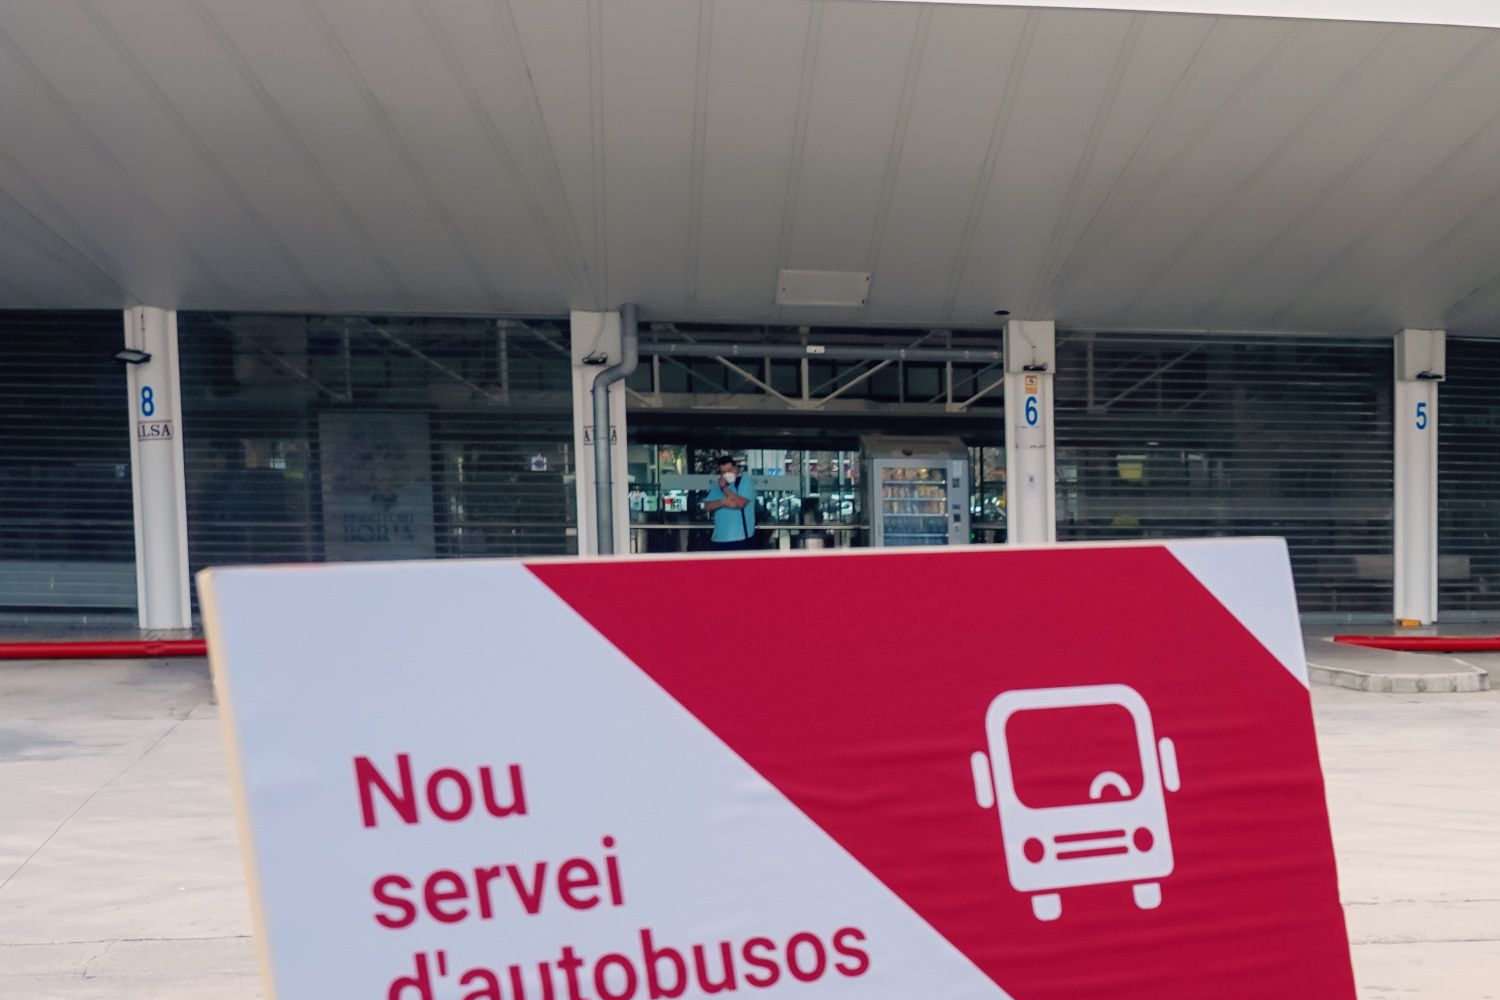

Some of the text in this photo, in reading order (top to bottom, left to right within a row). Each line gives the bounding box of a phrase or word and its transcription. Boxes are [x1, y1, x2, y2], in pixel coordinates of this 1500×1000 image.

[142, 386, 155, 417] 8
[1025, 396, 1038, 426] 6
[1416, 402, 1427, 430] 5
[138, 424, 171, 438] LSA
[353, 752, 528, 829] Nou
[371, 835, 626, 930] servei
